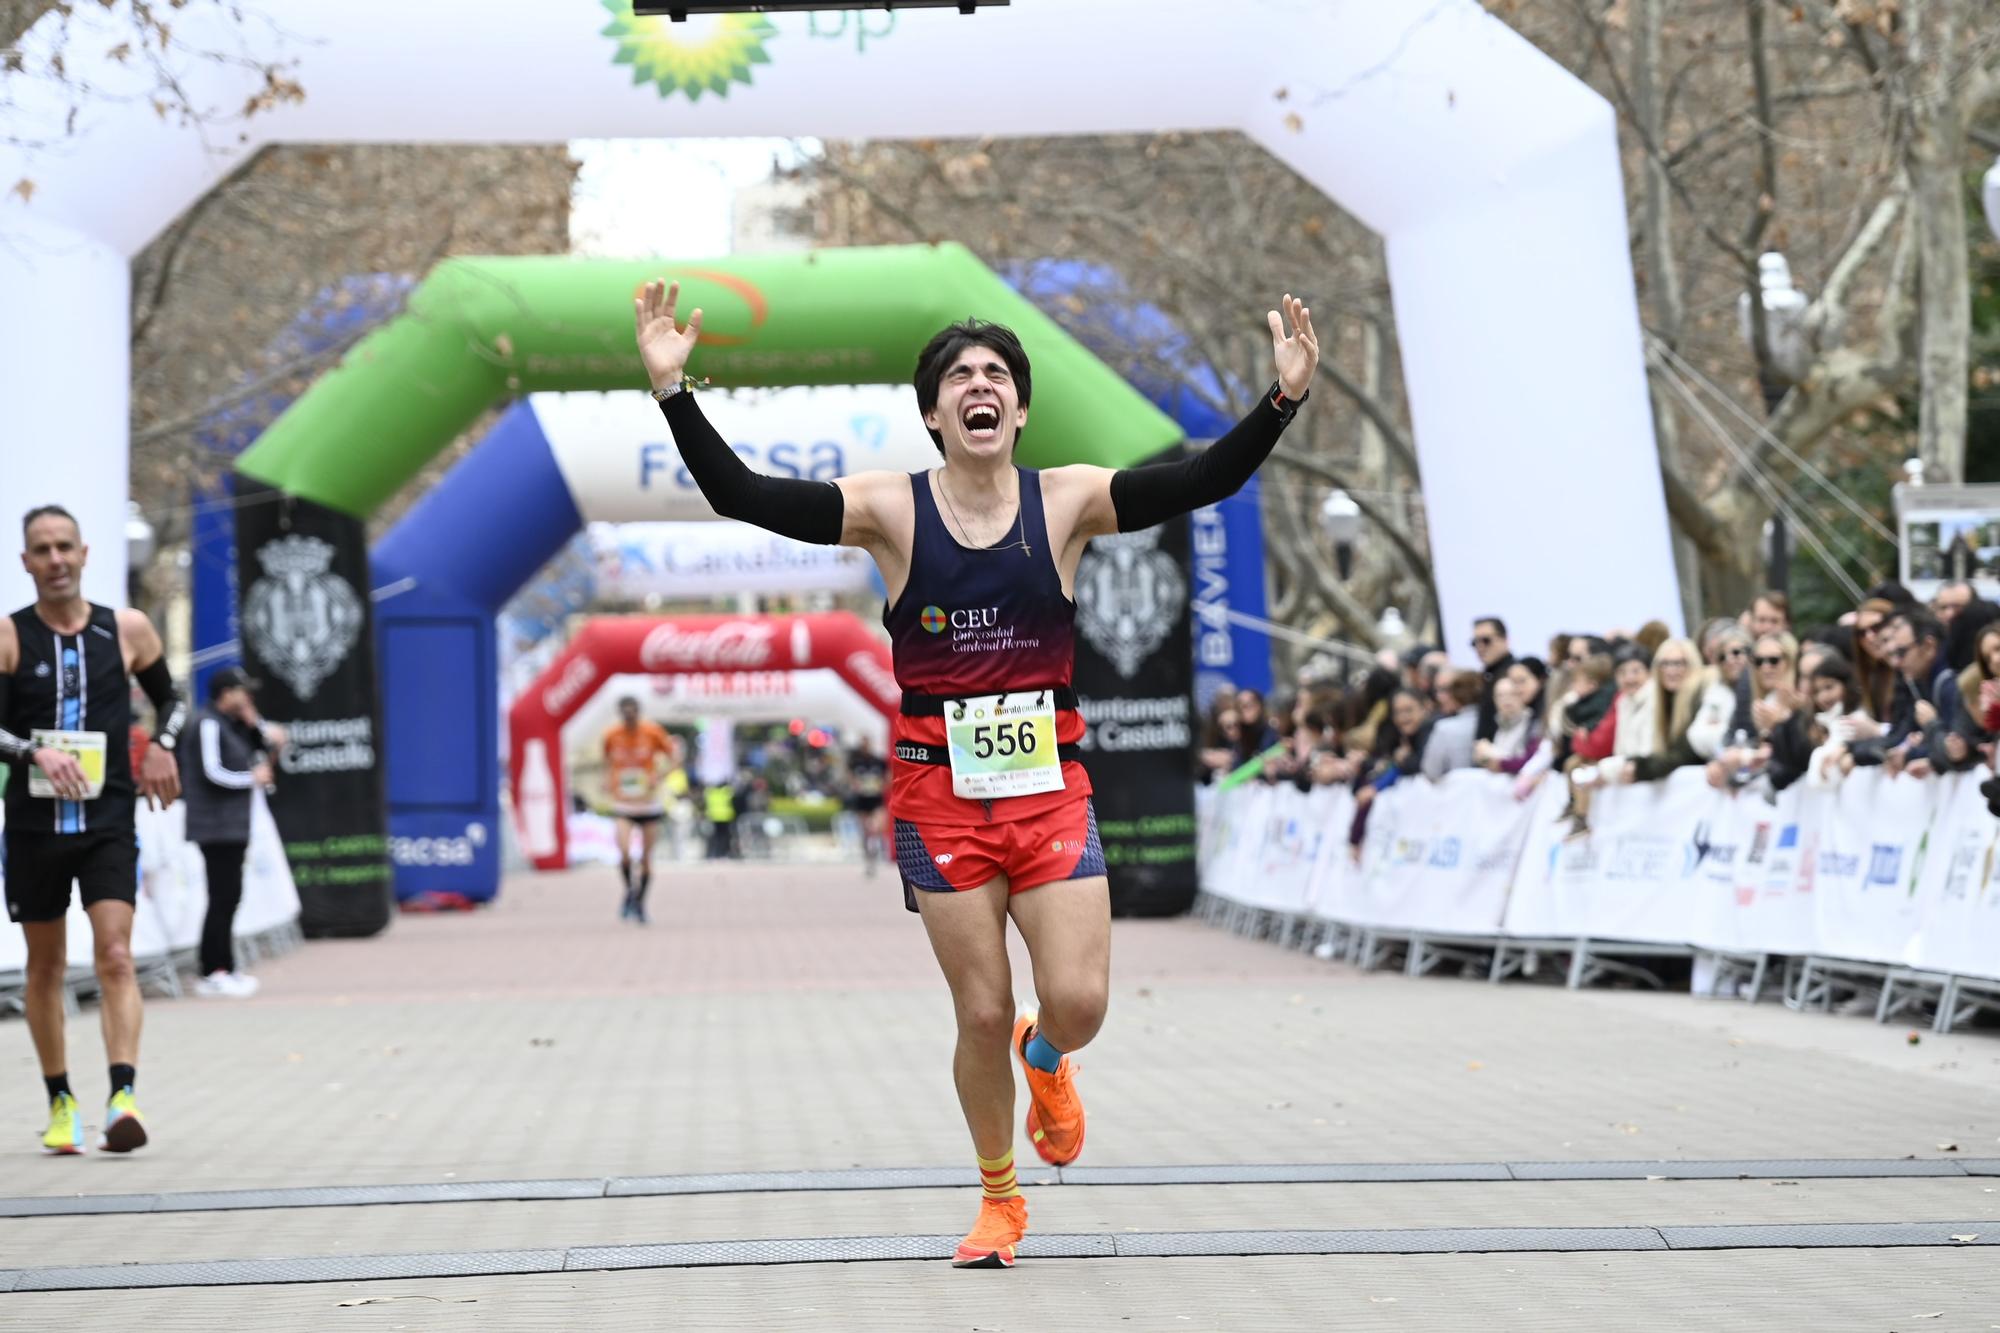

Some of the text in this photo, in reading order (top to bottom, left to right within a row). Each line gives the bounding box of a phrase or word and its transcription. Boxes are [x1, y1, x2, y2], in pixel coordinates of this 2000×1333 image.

[638, 441, 846, 490] Fsa
[951, 607, 999, 629] CEU
[952, 624, 1014, 642] Universidad
[952, 637, 1040, 653] Cardenal Herrera
[974, 721, 1036, 759] 556
[896, 746, 930, 761] oma
